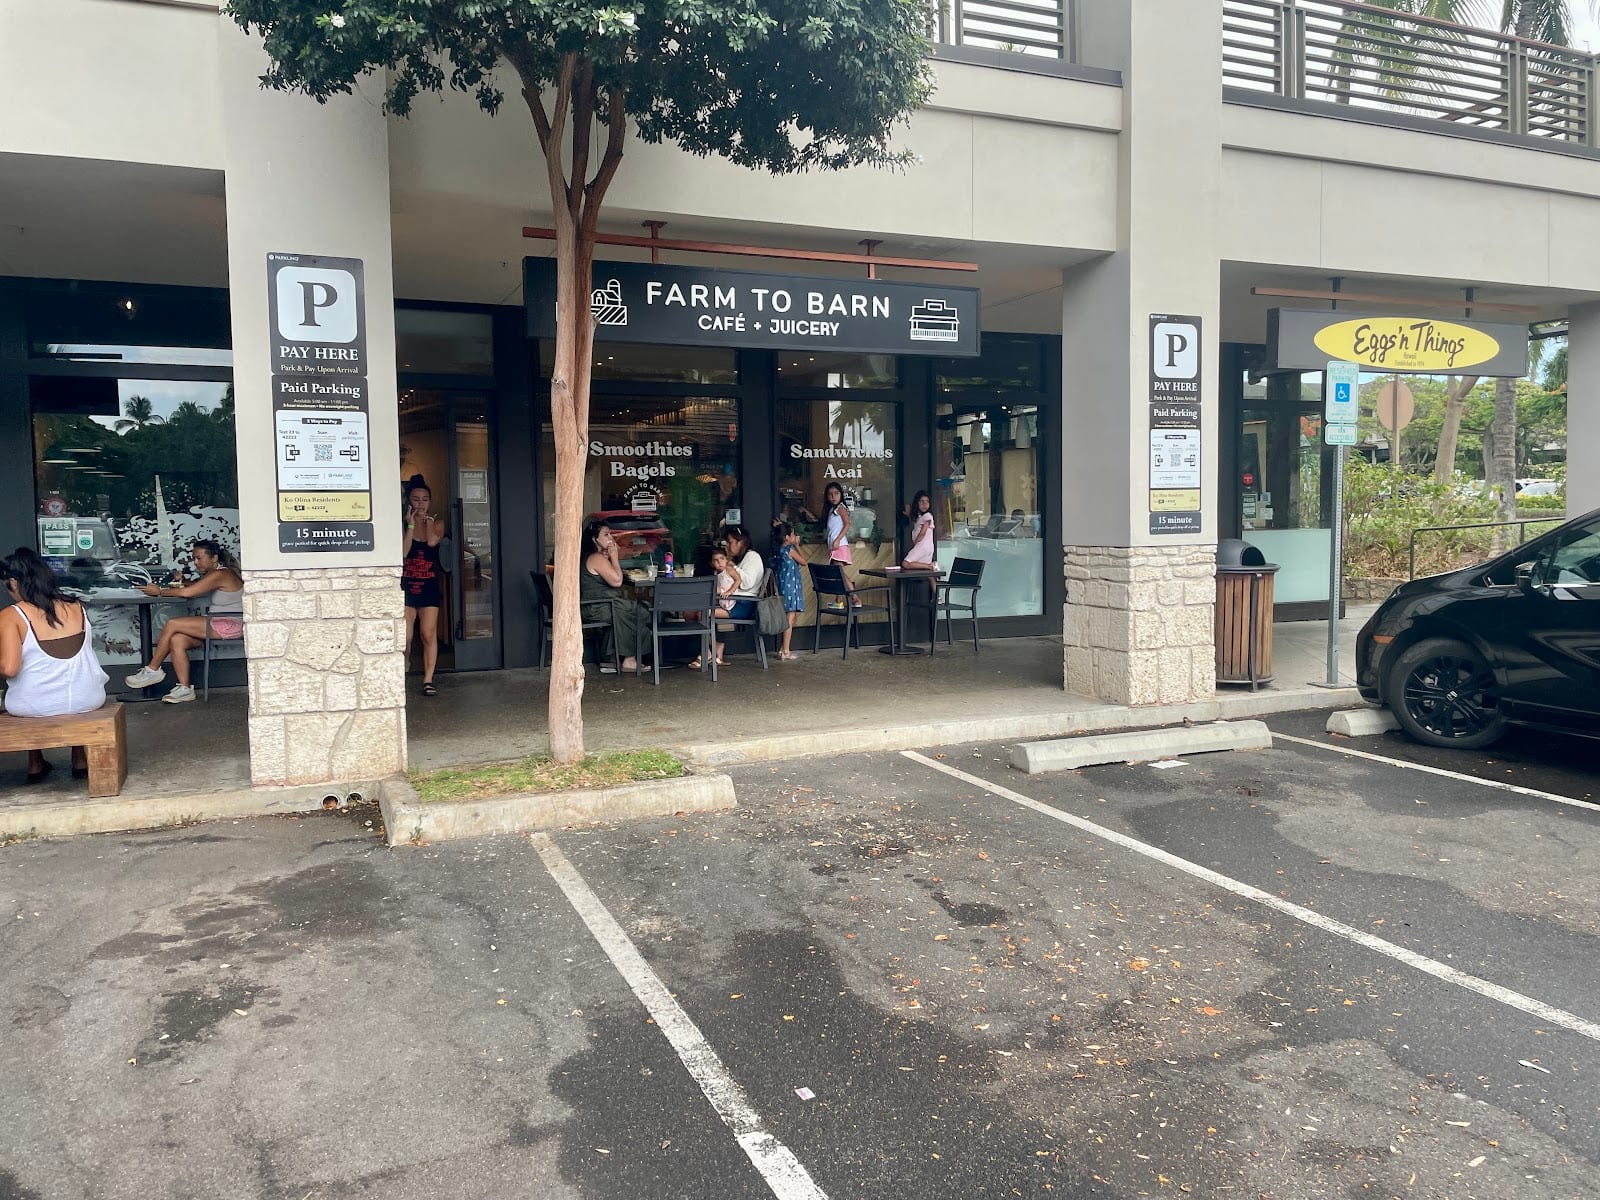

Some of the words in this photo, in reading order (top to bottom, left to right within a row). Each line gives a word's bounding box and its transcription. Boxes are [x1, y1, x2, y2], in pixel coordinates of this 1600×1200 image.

[297, 281, 338, 327] P
[646, 281, 736, 310] FARM
[750, 288, 792, 313] TO
[807, 291, 890, 319] BARN
[698, 312, 746, 332] CAFÉ
[769, 318, 840, 337] JUICERY
[1164, 333, 1188, 367] P
[1409, 321, 1465, 367] Things
[279, 345, 311, 359] PAY
[314, 347, 359, 361] HERE
[304, 365, 316, 374] Pay
[317, 366, 336, 375] Upon
[336, 366, 359, 374] Arrival
[280, 382, 308, 393] Paid
[311, 383, 361, 399] Parking
[1153, 381, 1171, 391] PAY
[1172, 382, 1198, 391] HERE
[1153, 407, 1169, 417] Paid
[1170, 407, 1198, 420] Parking
[589, 440, 693, 457] Smoothies
[790, 443, 894, 459] Sandwiches
[609, 461, 676, 481] Bagels
[823, 463, 862, 478] Acai
[623, 484, 638, 498] FARM
[649, 484, 664, 498] BARN
[45, 522, 70, 530] PASS
[1158, 516, 1167, 524] 15
[1167, 516, 1193, 524] minute
[296, 528, 310, 538] 15
[311, 527, 357, 538] minute
